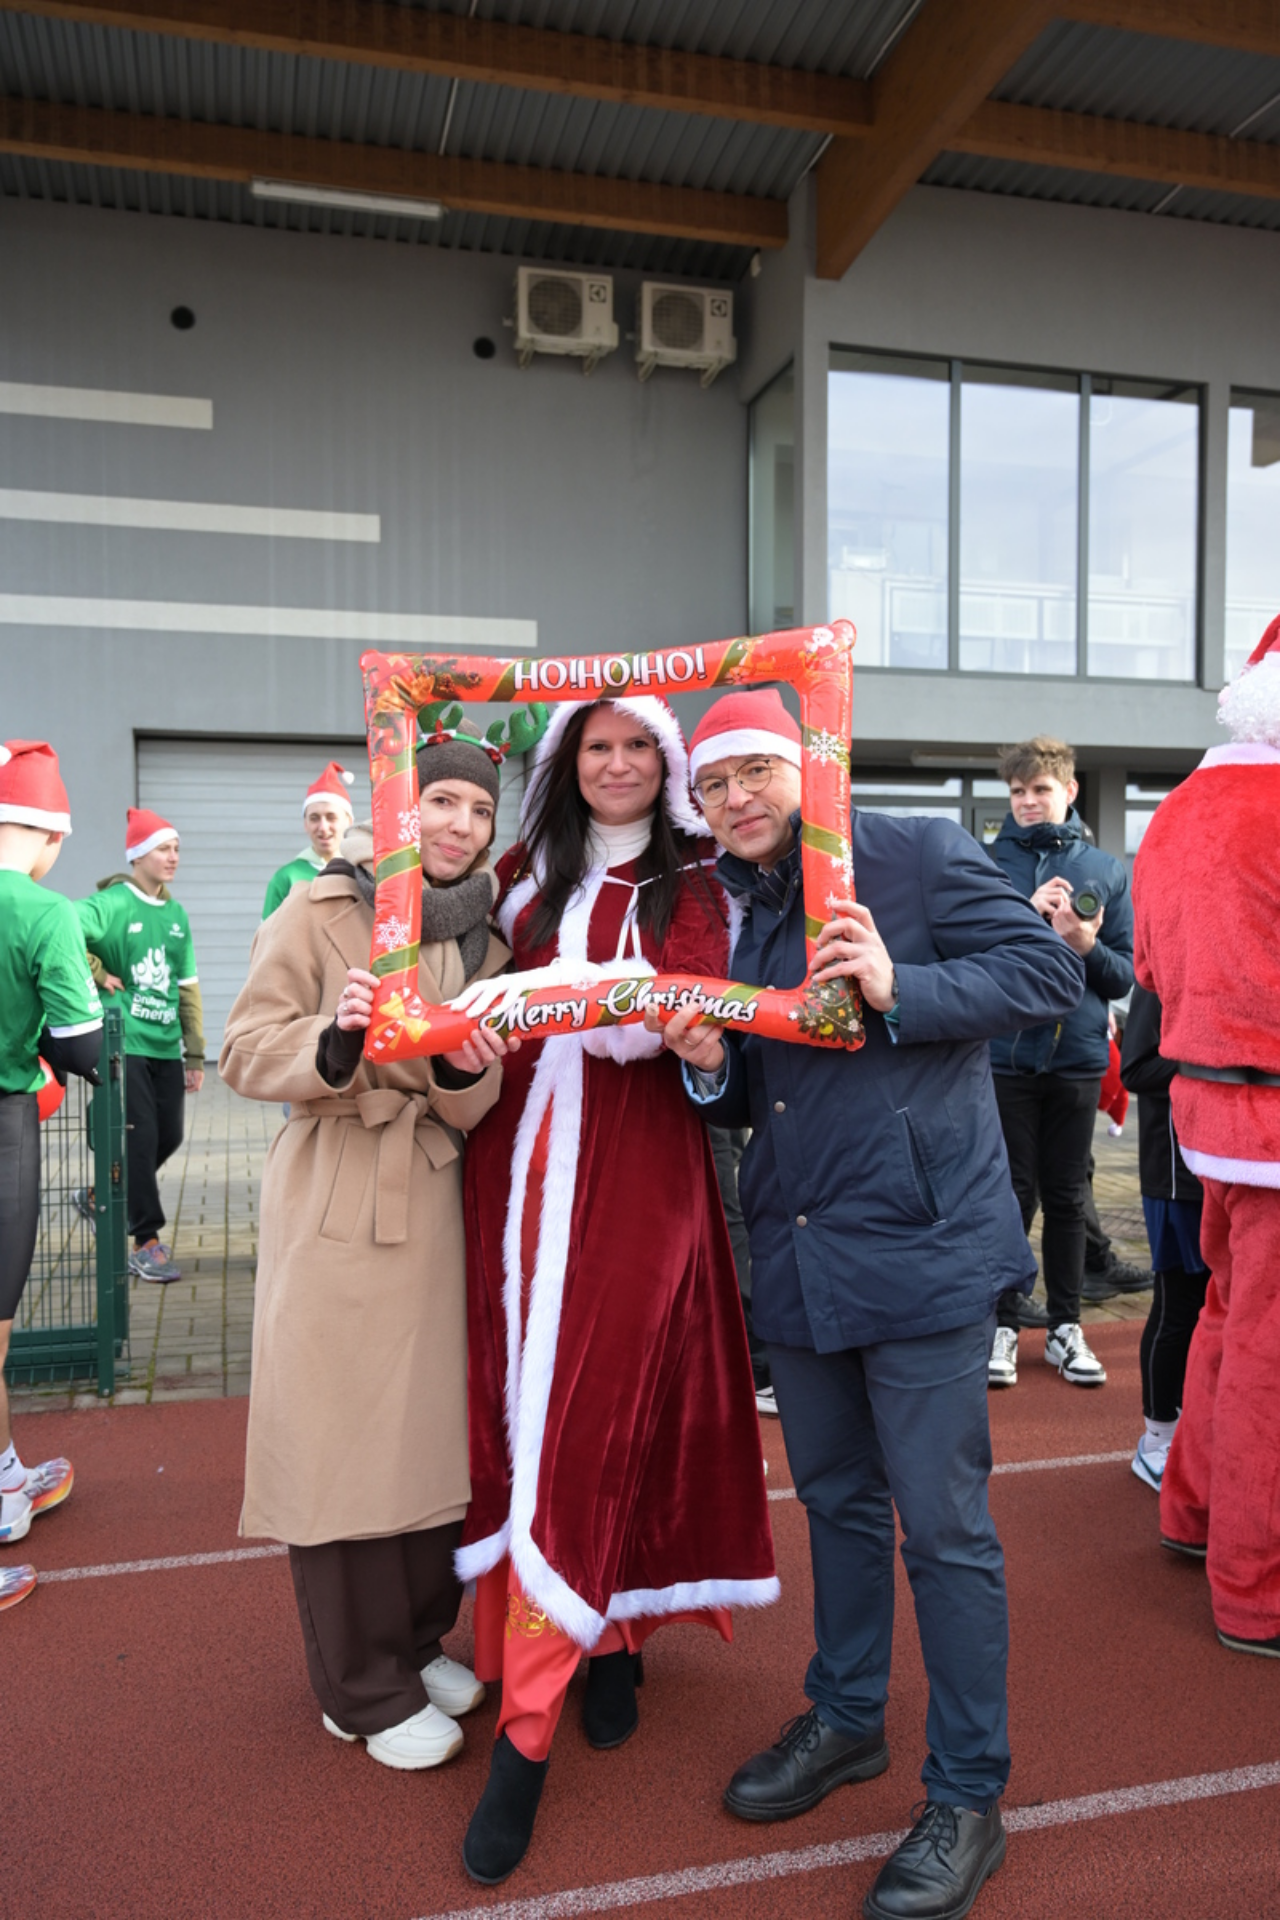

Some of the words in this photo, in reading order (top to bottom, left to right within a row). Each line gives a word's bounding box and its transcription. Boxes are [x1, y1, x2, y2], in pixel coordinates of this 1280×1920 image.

[513, 646, 707, 691] HO!HO!HO!
[479, 996, 588, 1032] Merry
[598, 980, 759, 1022] Christmas
